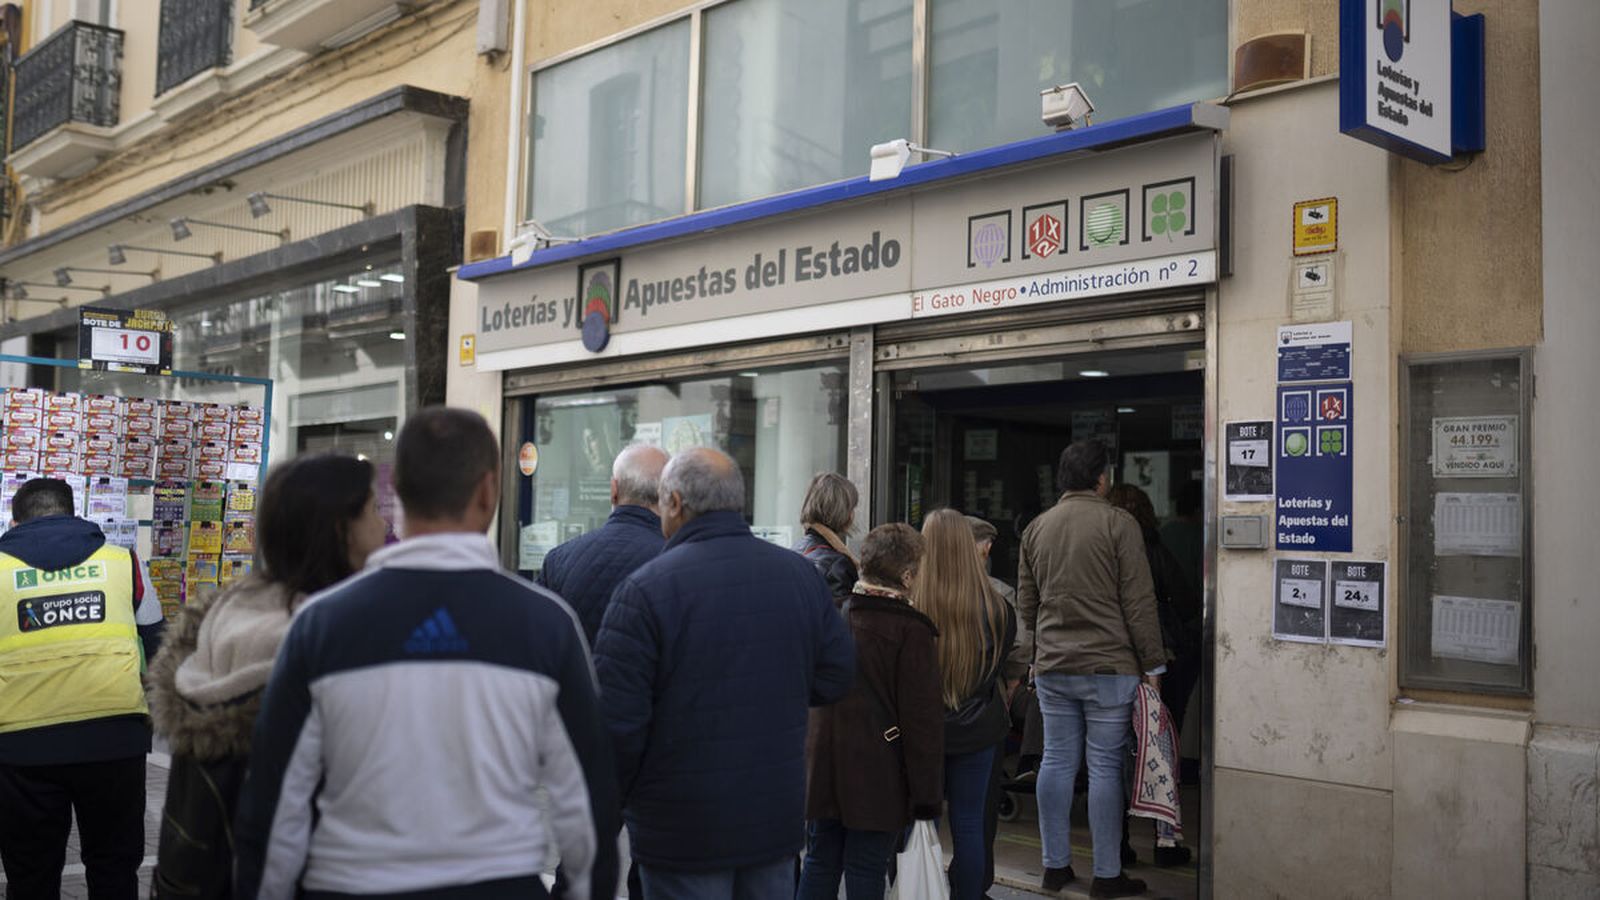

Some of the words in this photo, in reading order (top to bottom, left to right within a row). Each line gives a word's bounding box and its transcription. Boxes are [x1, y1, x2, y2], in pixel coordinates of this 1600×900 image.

[1378, 100, 1408, 126] Estado
[1419, 100, 1433, 118] del
[481, 295, 557, 333] Loterías
[562, 297, 575, 329] y
[624, 265, 737, 316] Apuestas
[744, 248, 787, 291] del
[795, 230, 901, 283] Estado
[913, 296, 925, 312] El
[931, 293, 965, 309] Gato
[972, 286, 1017, 306] Negro
[1029, 267, 1150, 298] Administración
[1188, 259, 1198, 278] 2
[83, 318, 108, 327] BOTE
[109, 321, 121, 329] DE
[1239, 426, 1257, 437] BOTE
[1241, 449, 1256, 460] 17
[1278, 496, 1323, 509] Loterías
[1325, 499, 1333, 511] y
[1278, 515, 1329, 528] Apuestas
[1331, 514, 1349, 526] del
[1278, 532, 1316, 544] Estado
[42, 565, 100, 582] ONCE
[1291, 564, 1310, 576] BOTE
[1347, 566, 1367, 577] BOTE
[43, 599, 72, 610] grupo
[74, 594, 101, 604] social
[43, 605, 101, 624] ONCE
